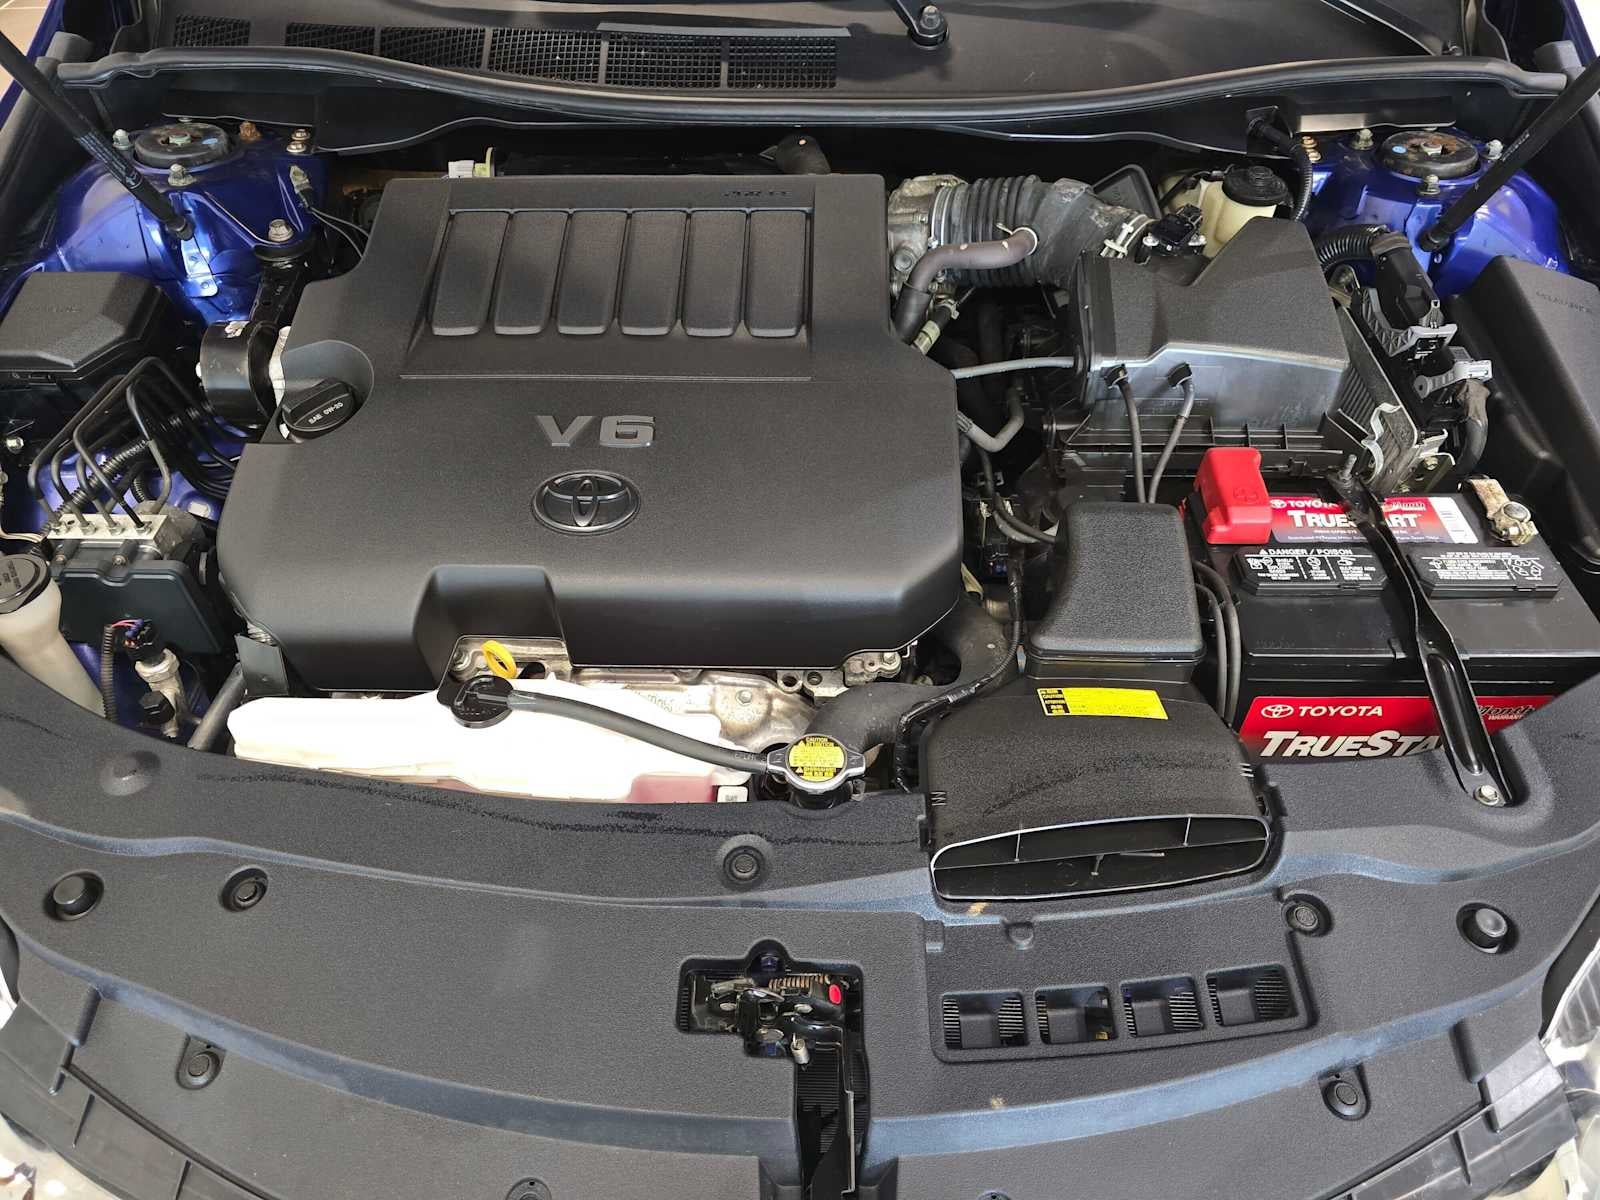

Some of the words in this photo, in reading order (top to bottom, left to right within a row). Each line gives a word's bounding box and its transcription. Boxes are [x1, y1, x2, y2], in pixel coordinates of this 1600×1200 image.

[308, 413, 323, 424] SAE
[535, 414, 656, 448] V6
[1298, 705, 1383, 717] TOYOTA
[1259, 730, 1442, 757] TRUESTA
